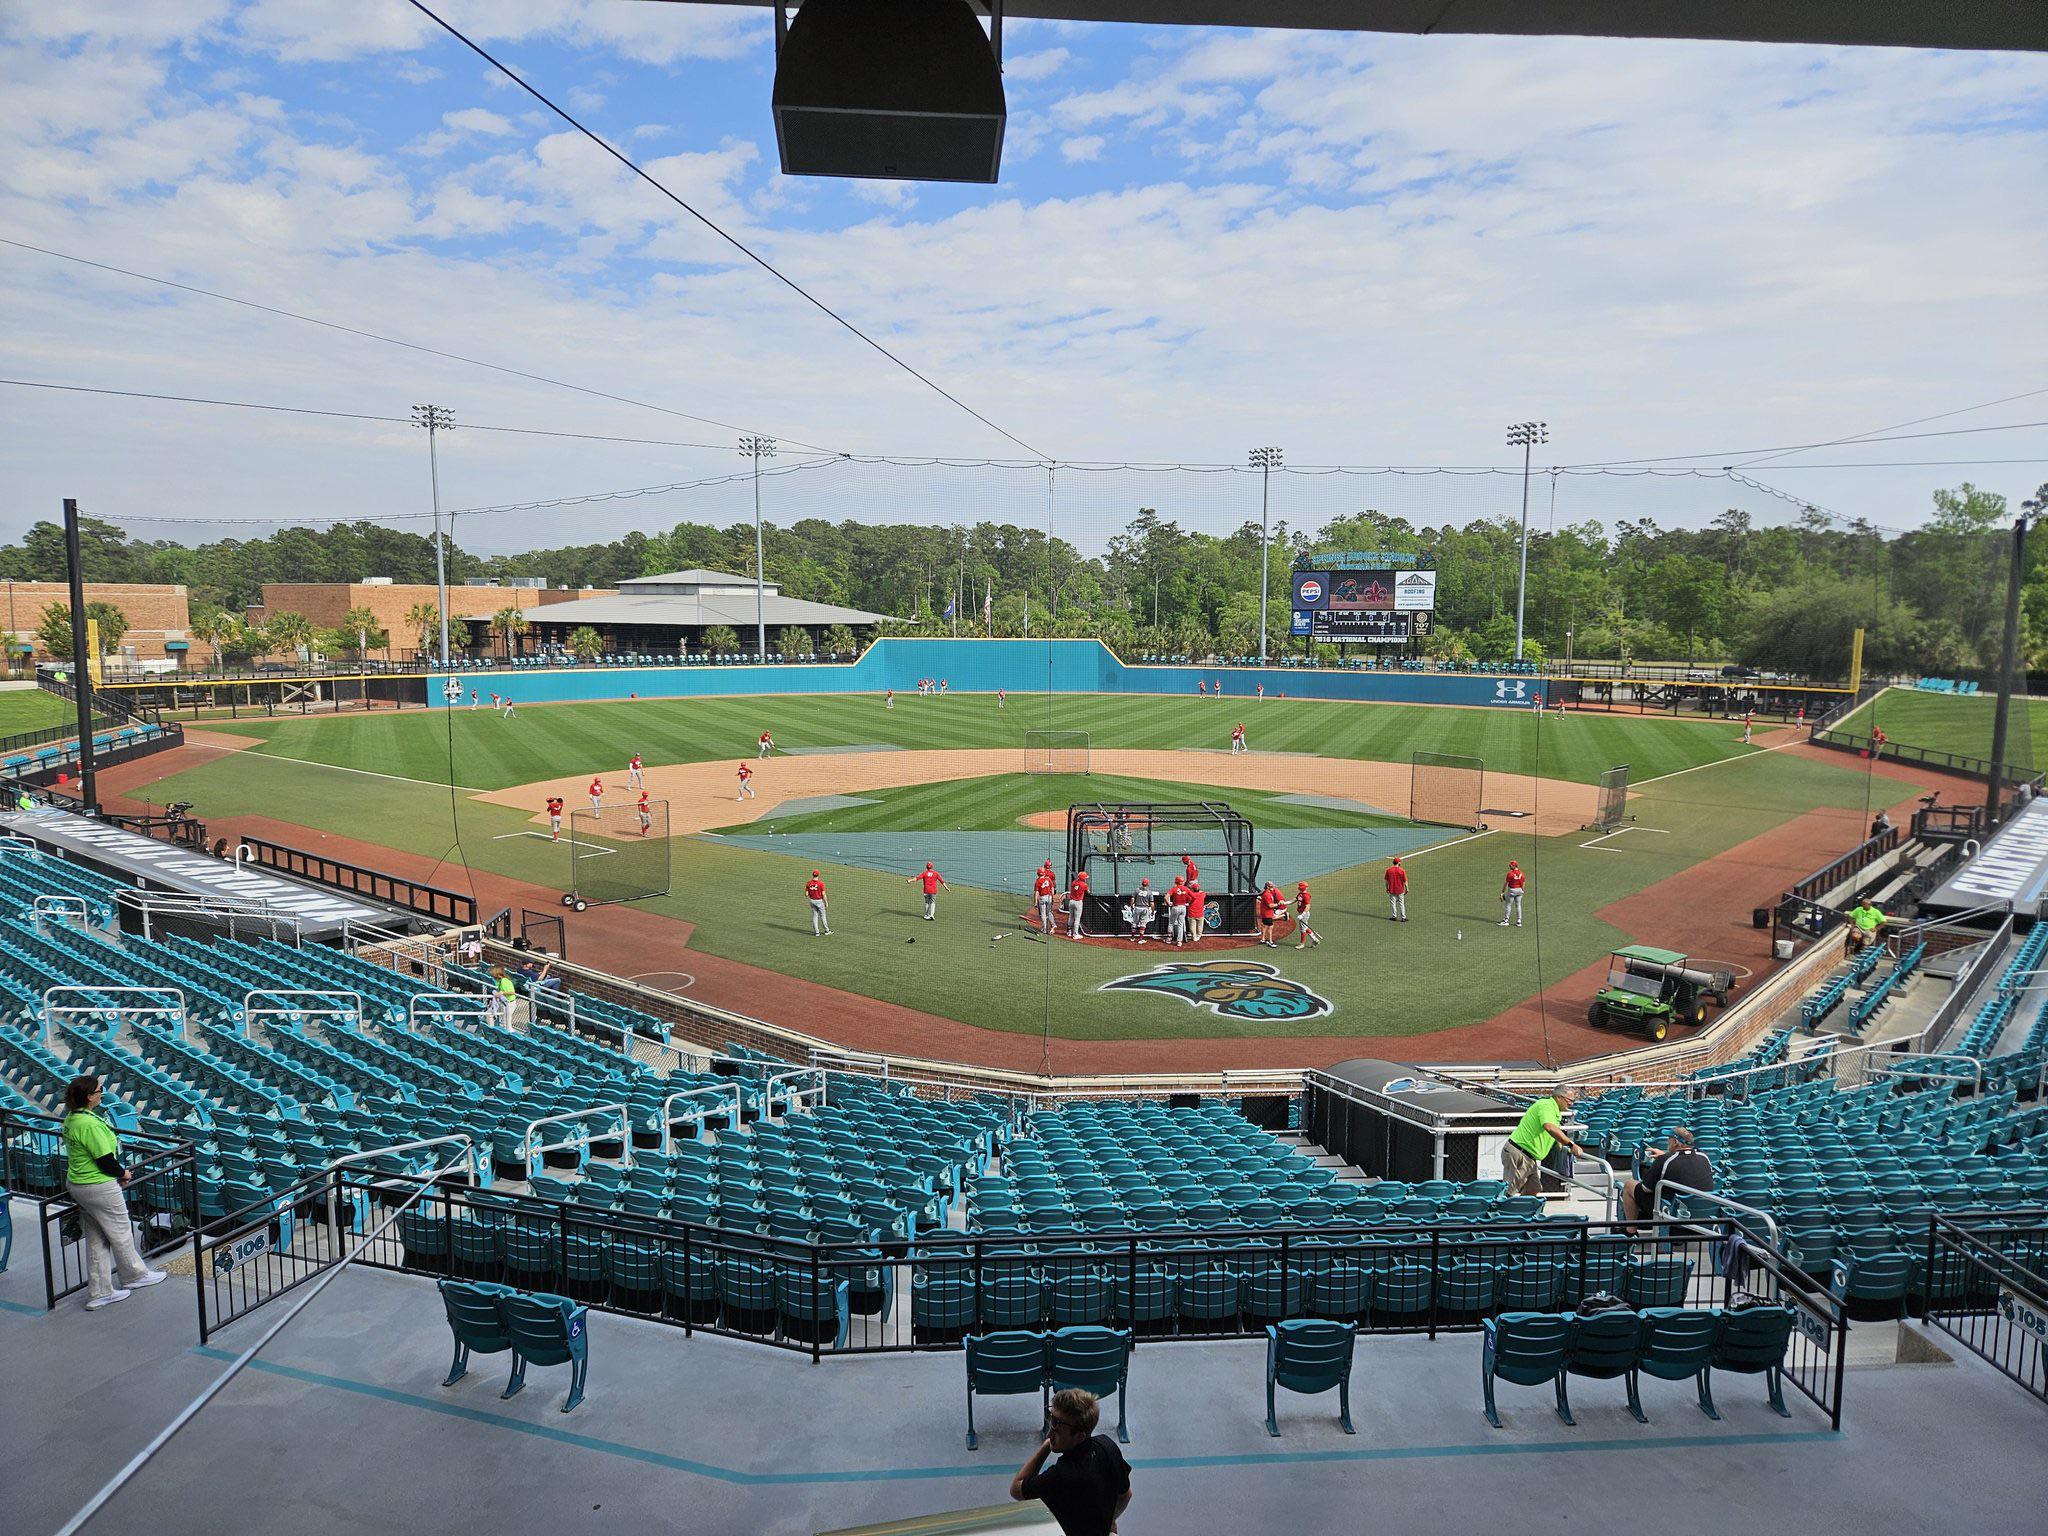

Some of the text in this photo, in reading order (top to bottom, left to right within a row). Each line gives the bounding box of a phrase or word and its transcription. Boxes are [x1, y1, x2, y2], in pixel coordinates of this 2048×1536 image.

[36, 820, 380, 922] COASTAL CAROLINA
[235, 1235, 265, 1260] 106
[2017, 1305, 2047, 1336] 105
